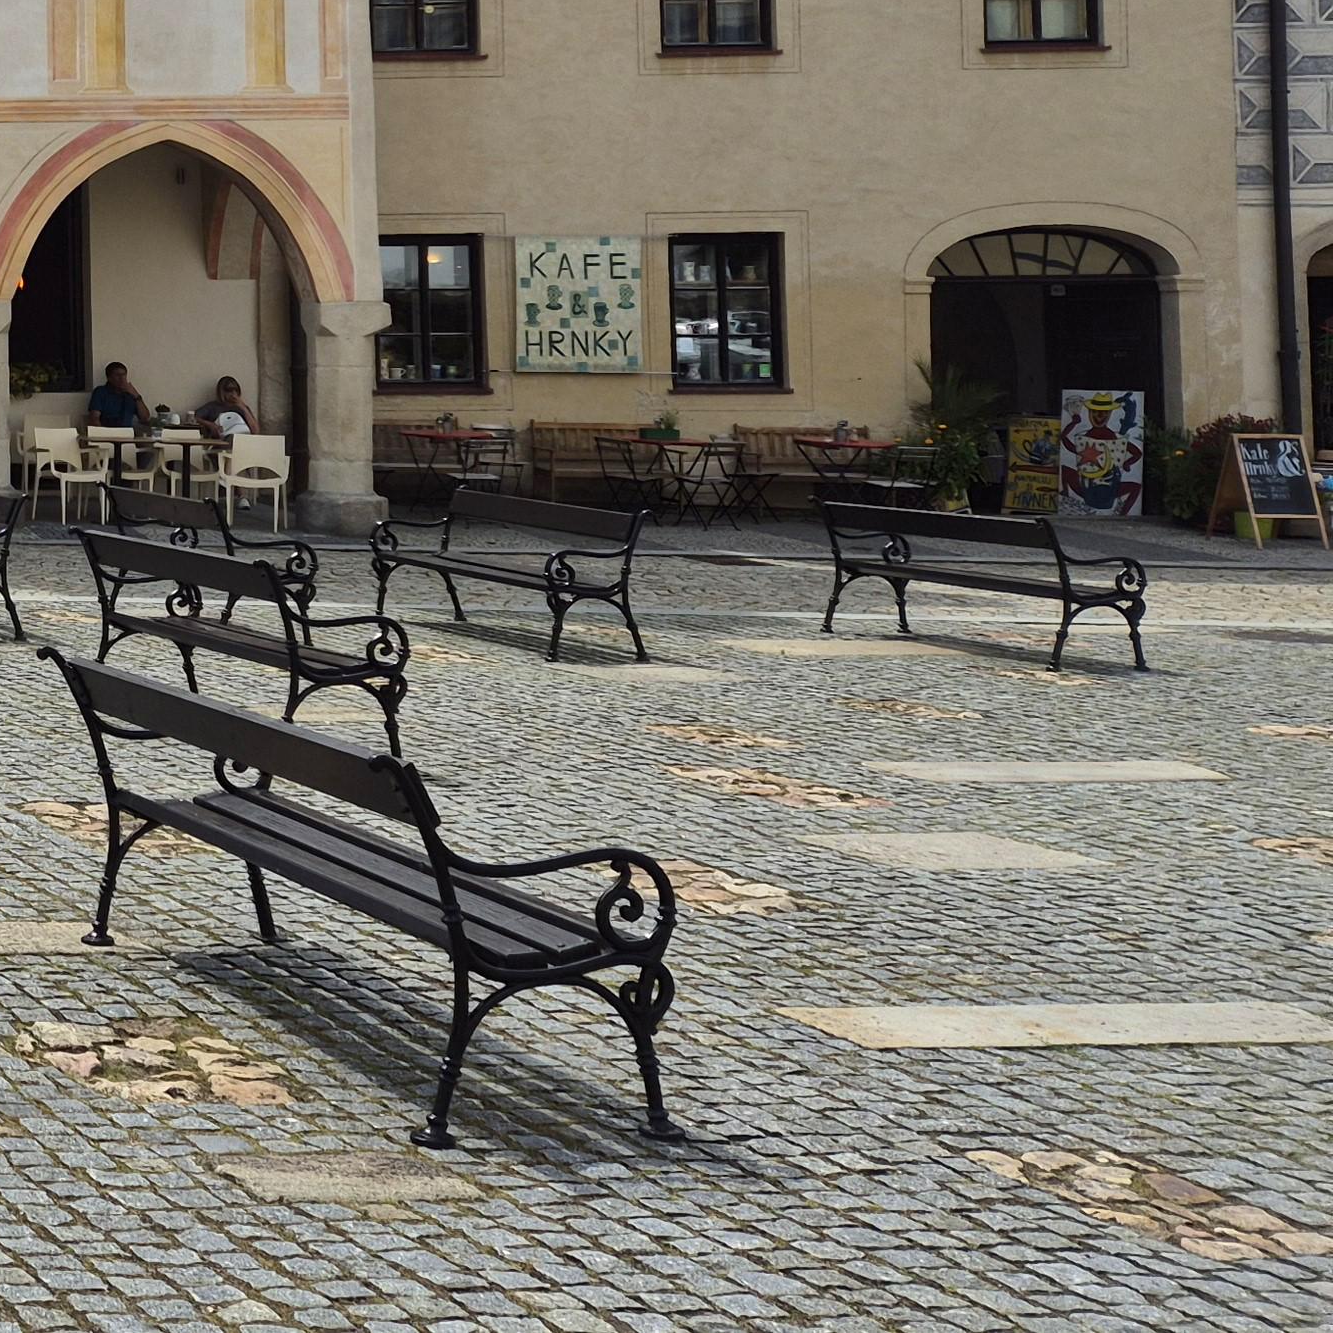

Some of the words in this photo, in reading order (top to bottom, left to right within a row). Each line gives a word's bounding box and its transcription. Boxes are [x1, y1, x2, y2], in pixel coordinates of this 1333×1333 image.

[529, 251, 628, 280] KAFE
[572, 293, 588, 316] &
[524, 329, 633, 357] HRNKY
